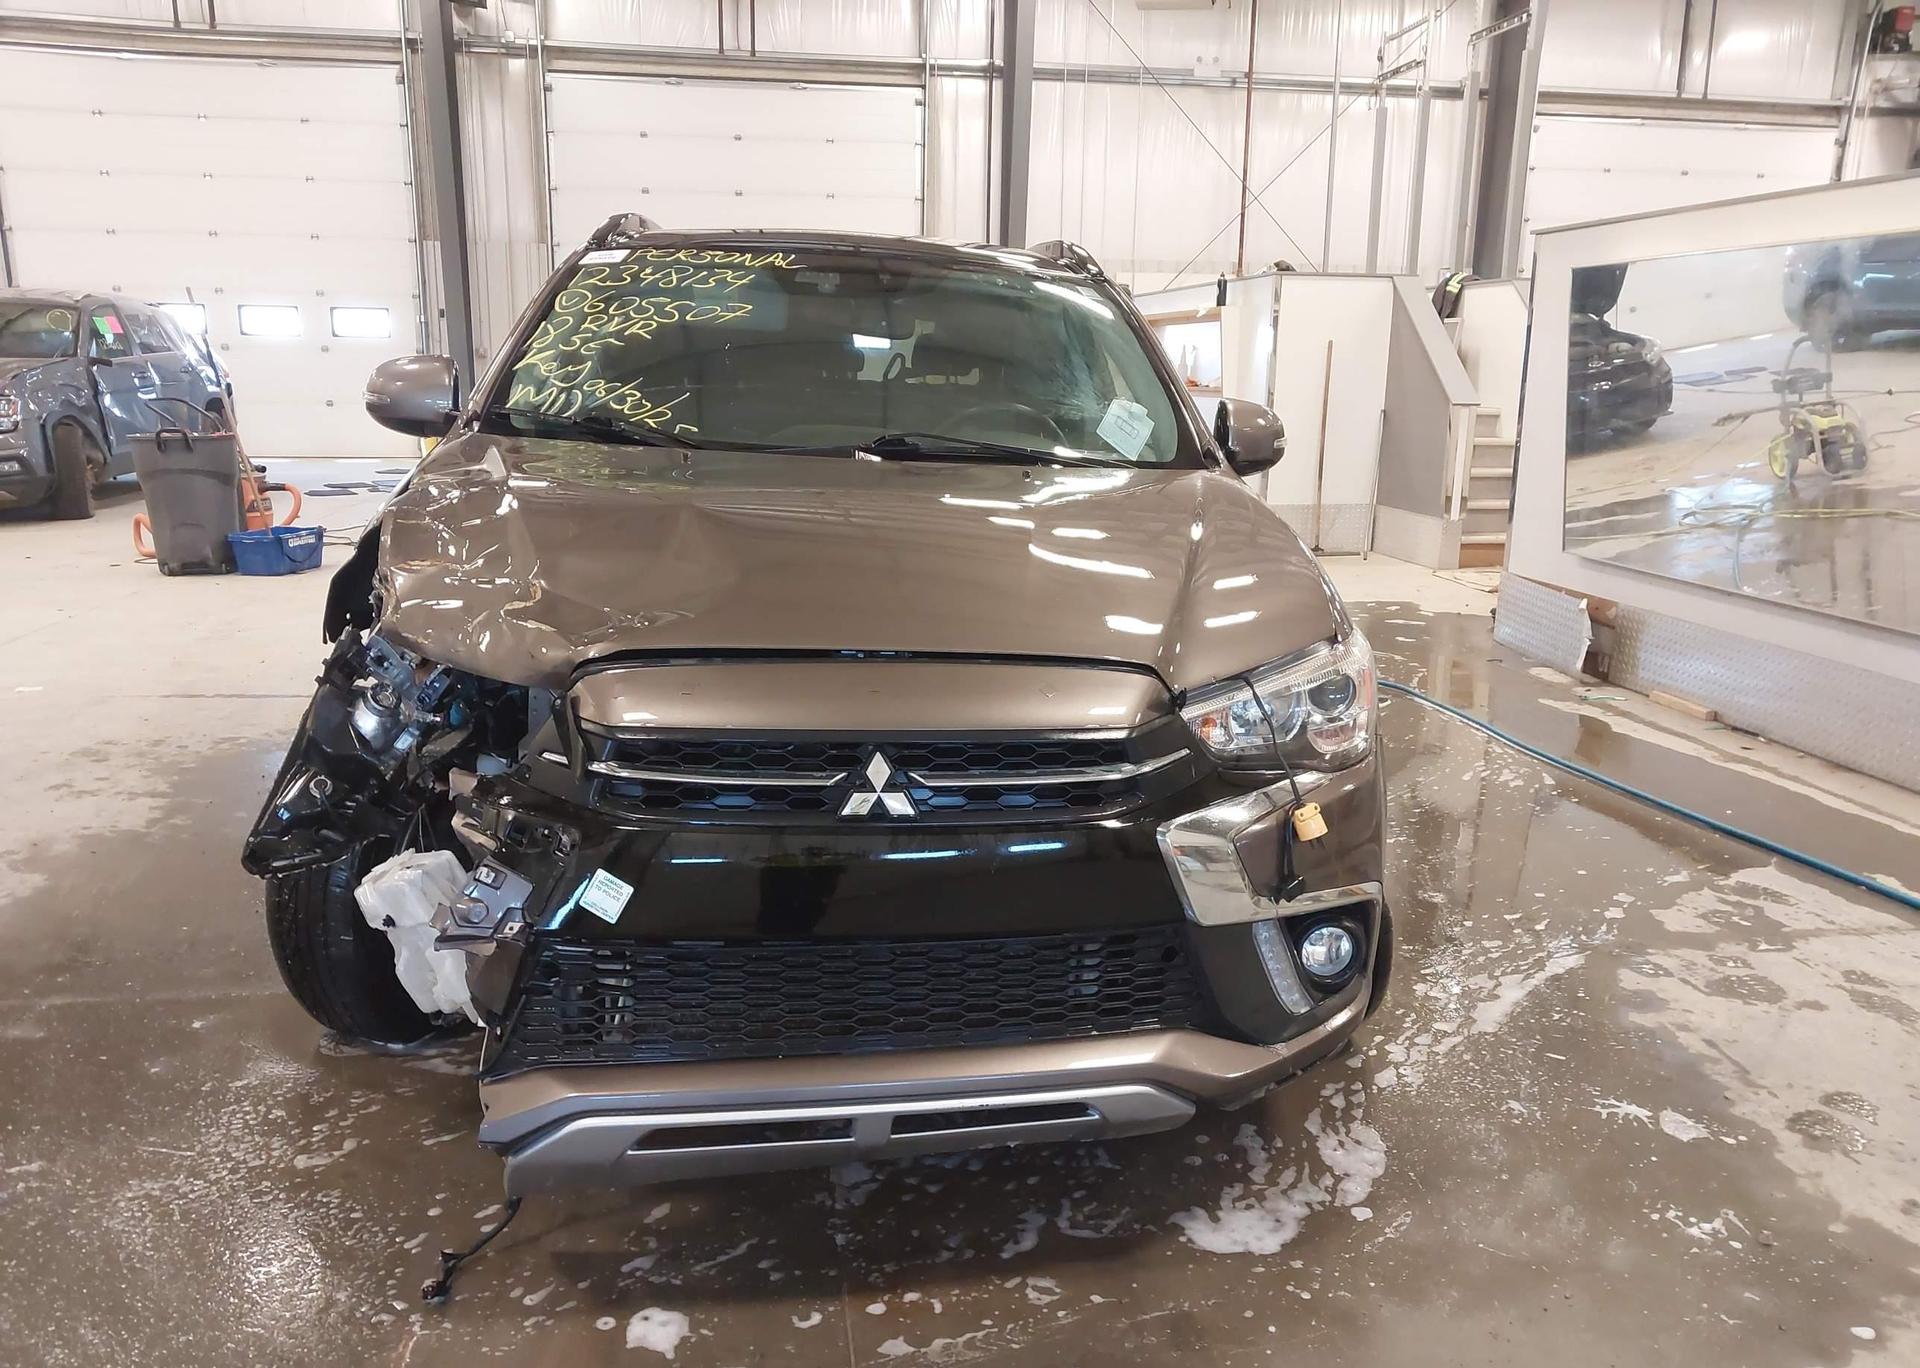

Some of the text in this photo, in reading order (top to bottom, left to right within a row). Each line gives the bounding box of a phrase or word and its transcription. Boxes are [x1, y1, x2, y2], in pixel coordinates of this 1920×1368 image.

[628, 248, 807, 269] PERSONAL
[581, 315, 657, 339] RVR
[598, 879, 624, 897] REPORTED
[602, 888, 621, 902] POLICE
